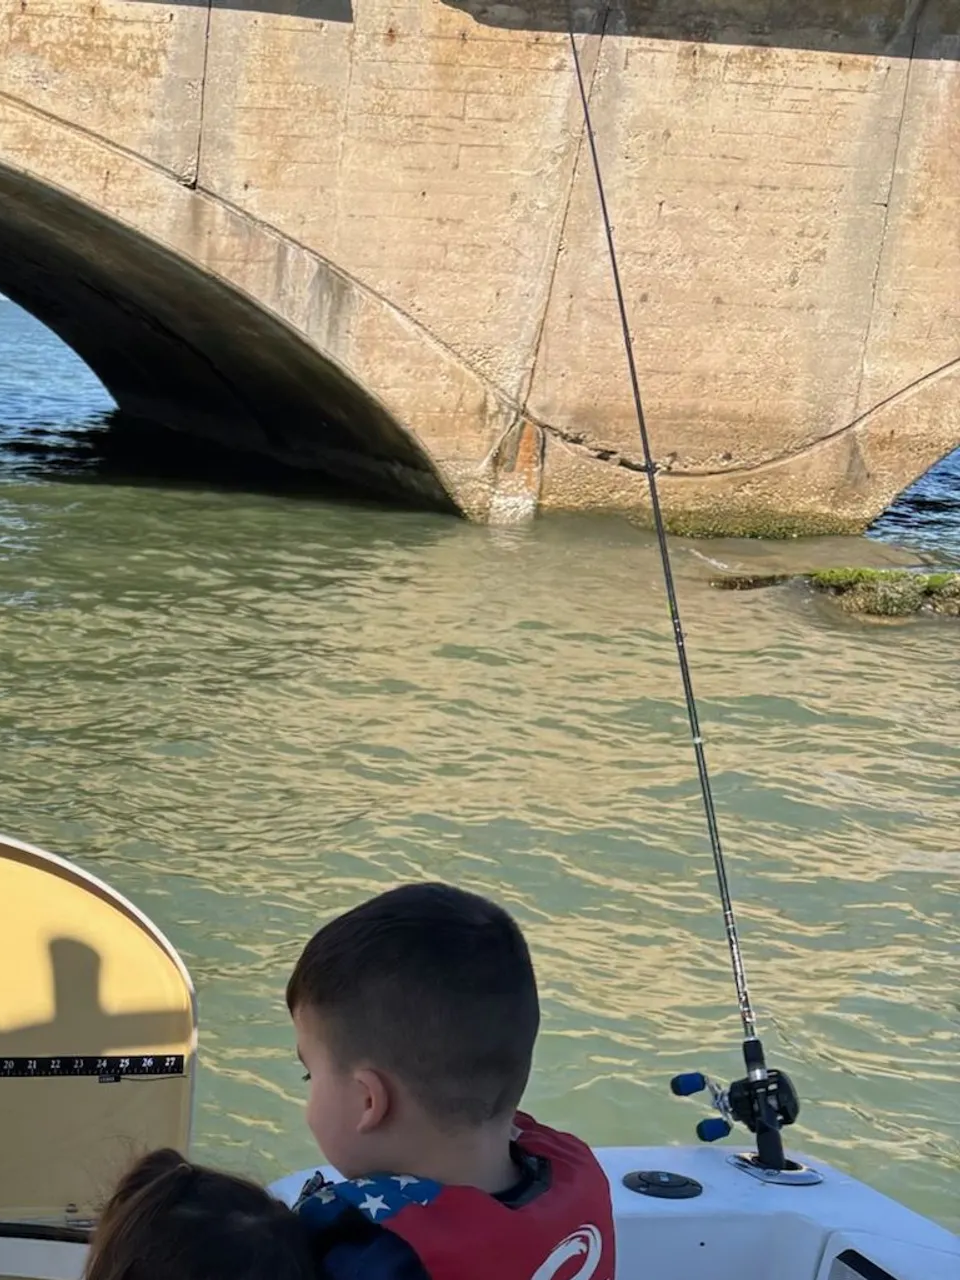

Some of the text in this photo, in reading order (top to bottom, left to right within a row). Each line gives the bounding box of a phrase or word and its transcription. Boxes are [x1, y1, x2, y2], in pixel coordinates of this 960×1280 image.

[3, 1060, 14, 1069] 20
[27, 1060, 37, 1069] 21
[50, 1060, 61, 1068] 22
[73, 1059, 84, 1068] 23
[96, 1058, 108, 1068] 24
[119, 1058, 130, 1068] 25
[142, 1057, 153, 1067] 26
[164, 1057, 176, 1066] 27
